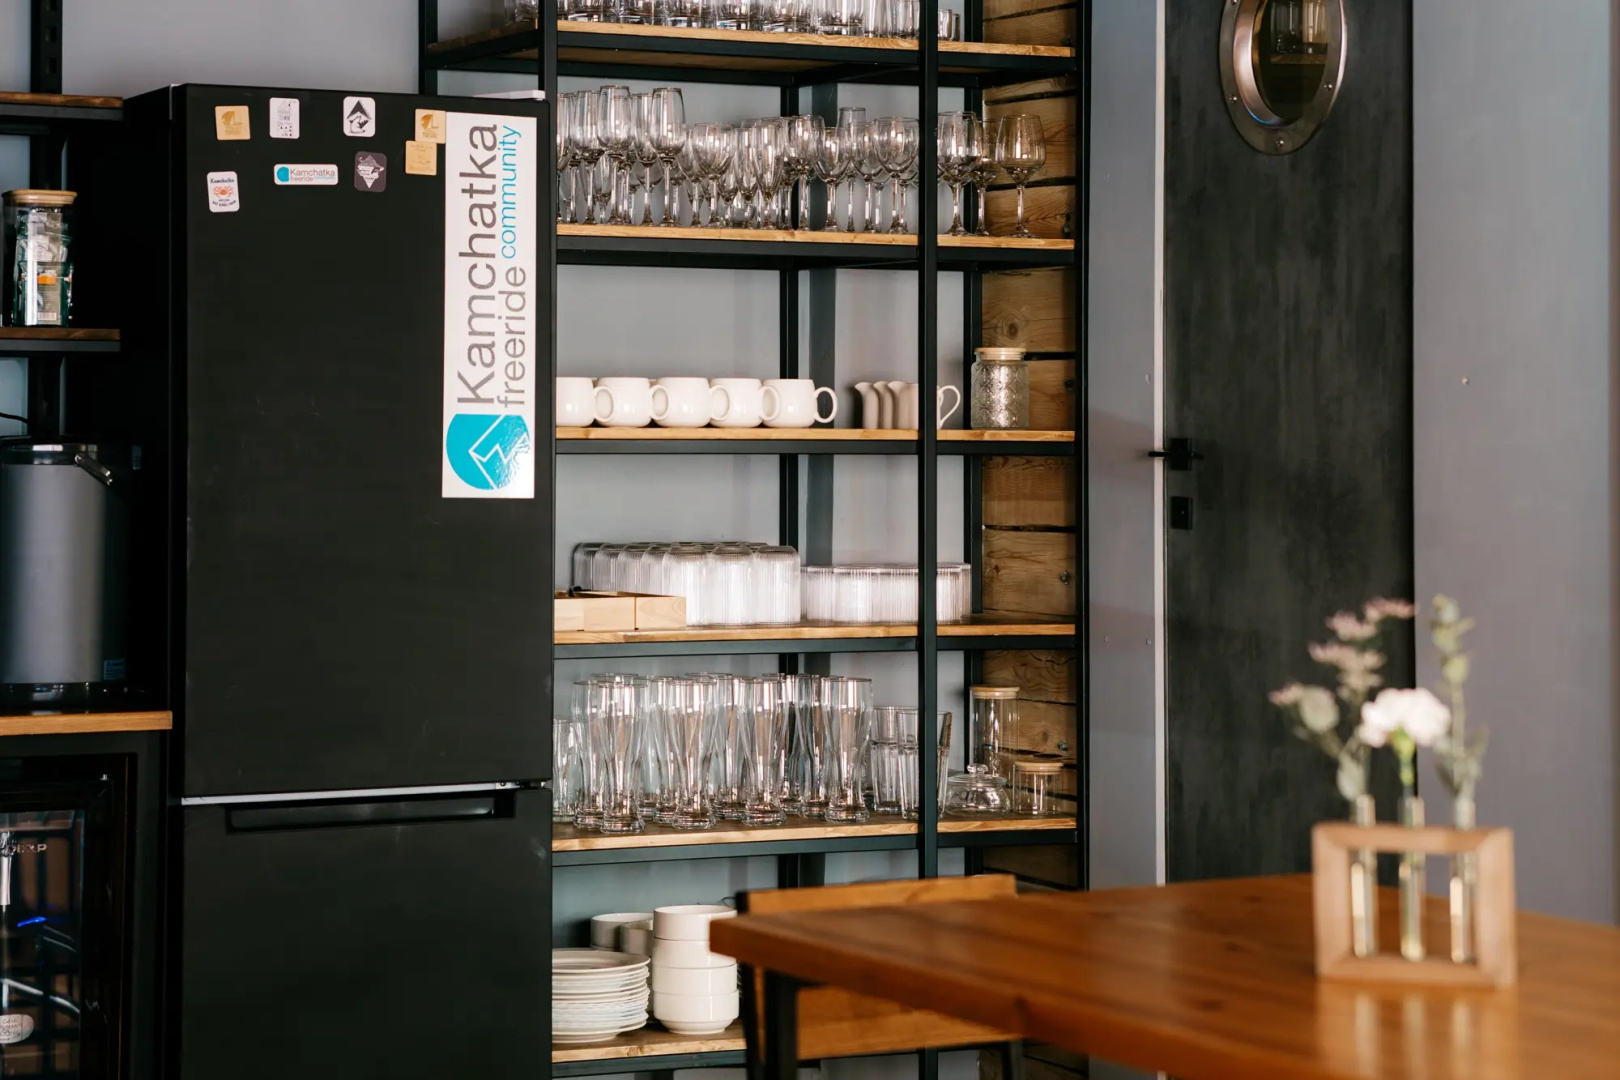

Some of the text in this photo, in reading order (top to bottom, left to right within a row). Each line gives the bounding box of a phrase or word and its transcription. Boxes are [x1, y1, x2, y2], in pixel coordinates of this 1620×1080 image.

[290, 168, 336, 176] Kamchatka
[457, 124, 497, 404] Kamchatka
[496, 125, 526, 407] freeride community
